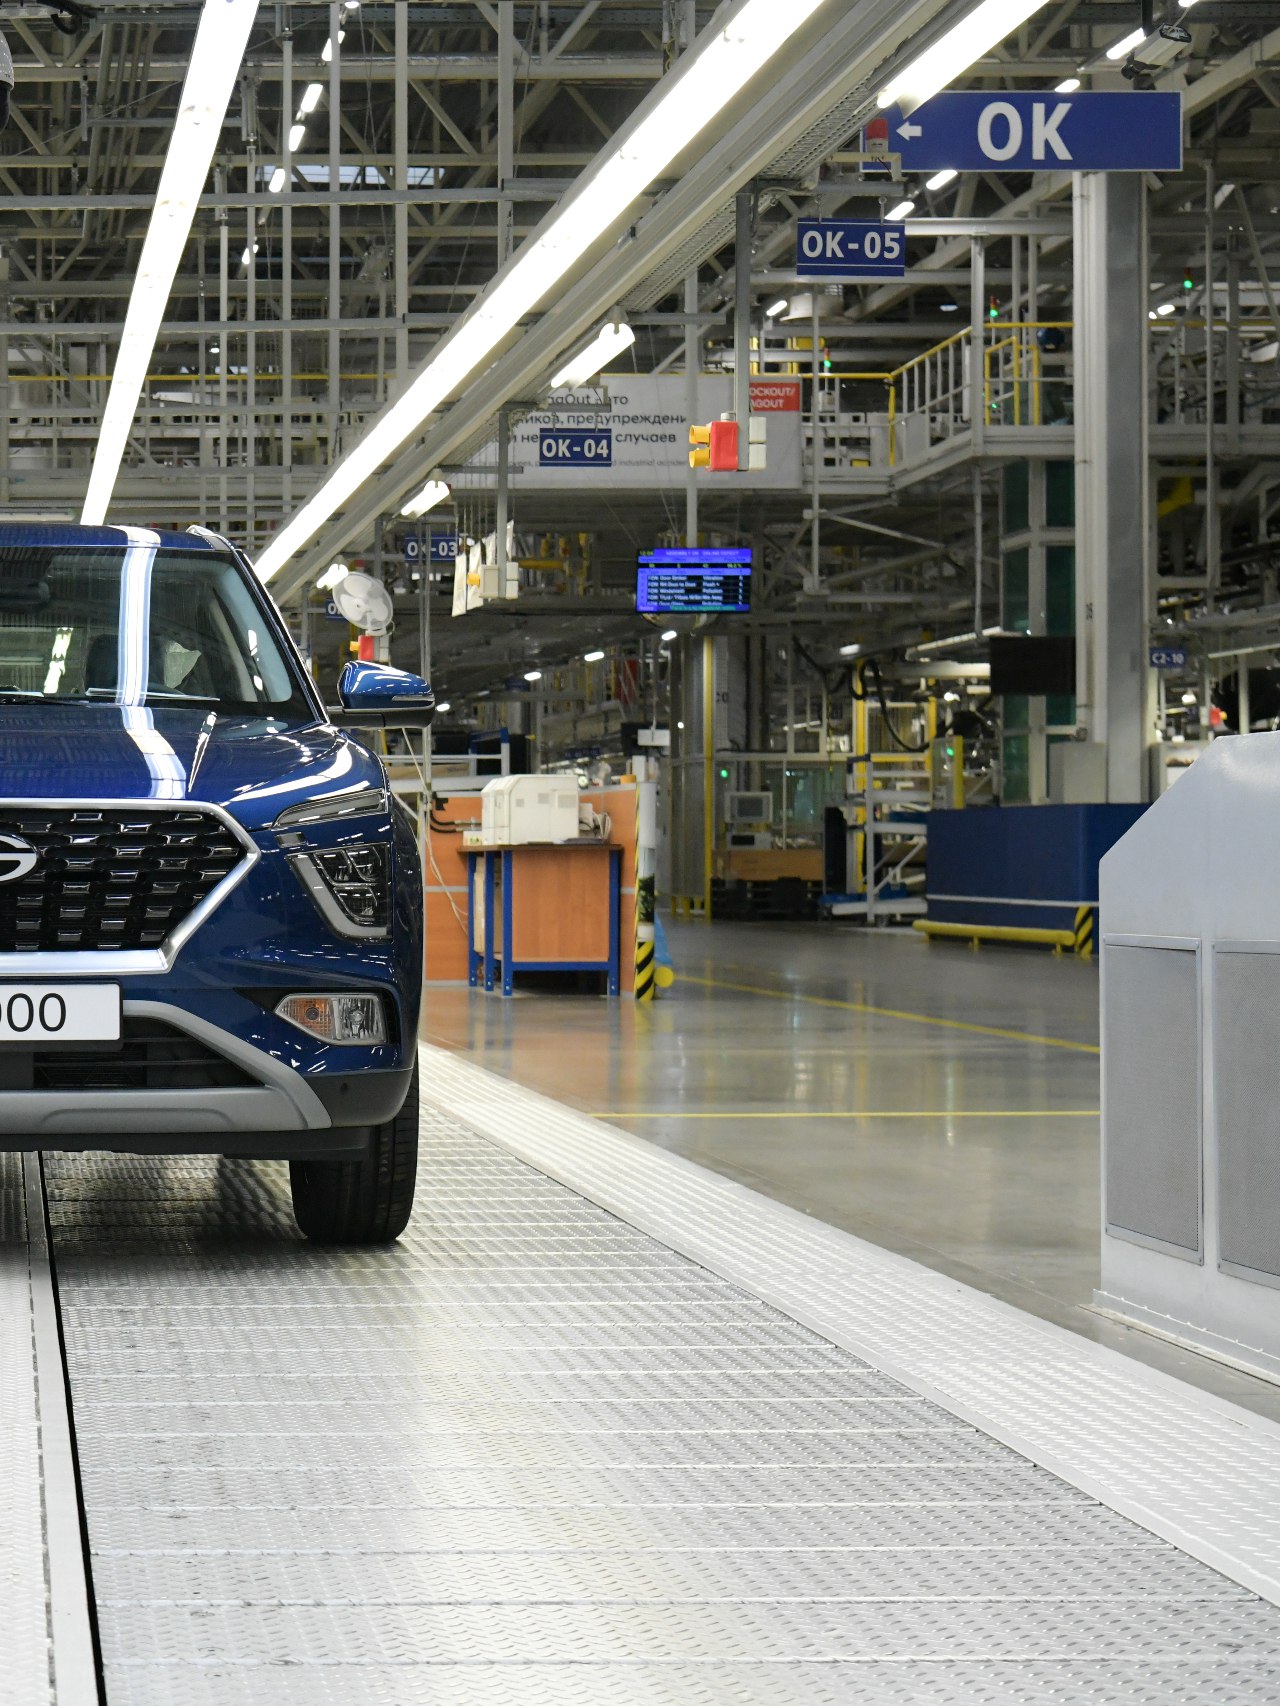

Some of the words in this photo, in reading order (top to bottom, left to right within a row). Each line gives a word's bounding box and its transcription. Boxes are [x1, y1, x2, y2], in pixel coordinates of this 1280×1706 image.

[977, 101, 1073, 161] OK
[802, 230, 900, 259] OK-05
[749, 386, 796, 396] OCKOUT/
[751, 399, 785, 408] AGOUT
[615, 433, 677, 445] случаев
[542, 438, 609, 458] OK-04
